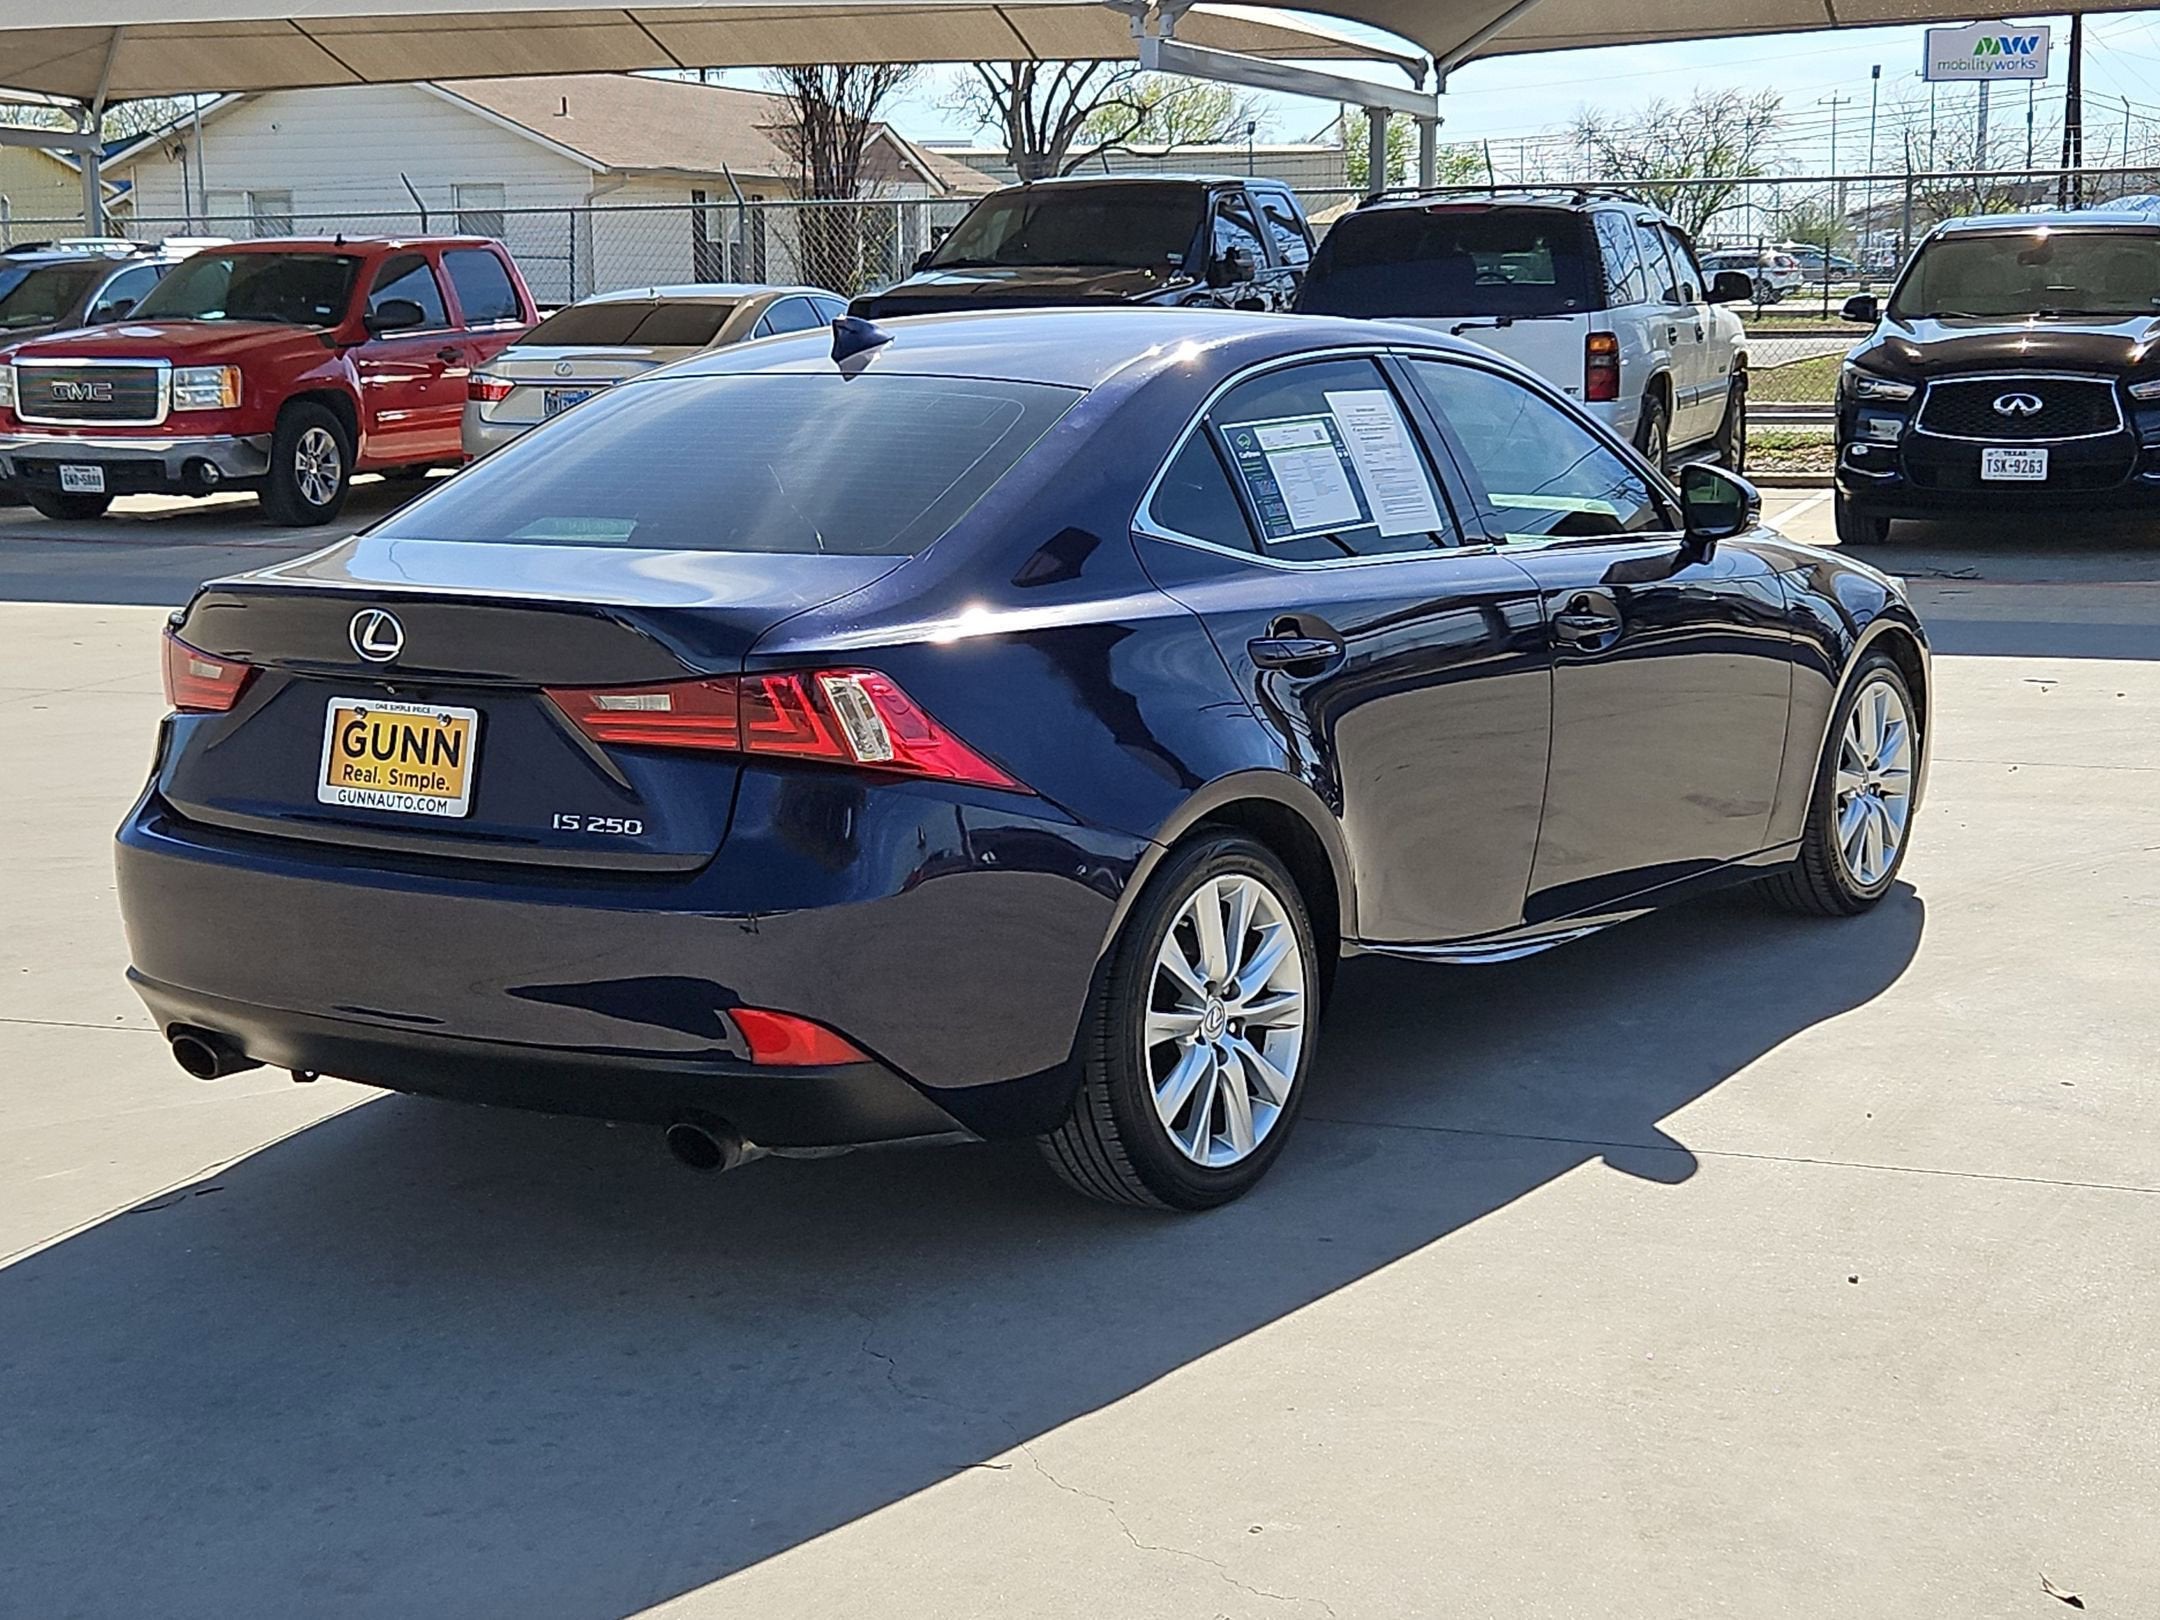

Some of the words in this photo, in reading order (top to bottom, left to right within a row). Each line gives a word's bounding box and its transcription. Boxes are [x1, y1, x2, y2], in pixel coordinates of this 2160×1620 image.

[1937, 57, 2038, 73] mobilityworks
[51, 381, 113, 401] GMC
[412, 706, 431, 714] PRICE
[342, 720, 462, 768] GUNN
[342, 763, 381, 784] Real.
[337, 788, 448, 814] GUNNAUTO.COM
[552, 813, 580, 830] IS
[586, 816, 643, 835] 250
